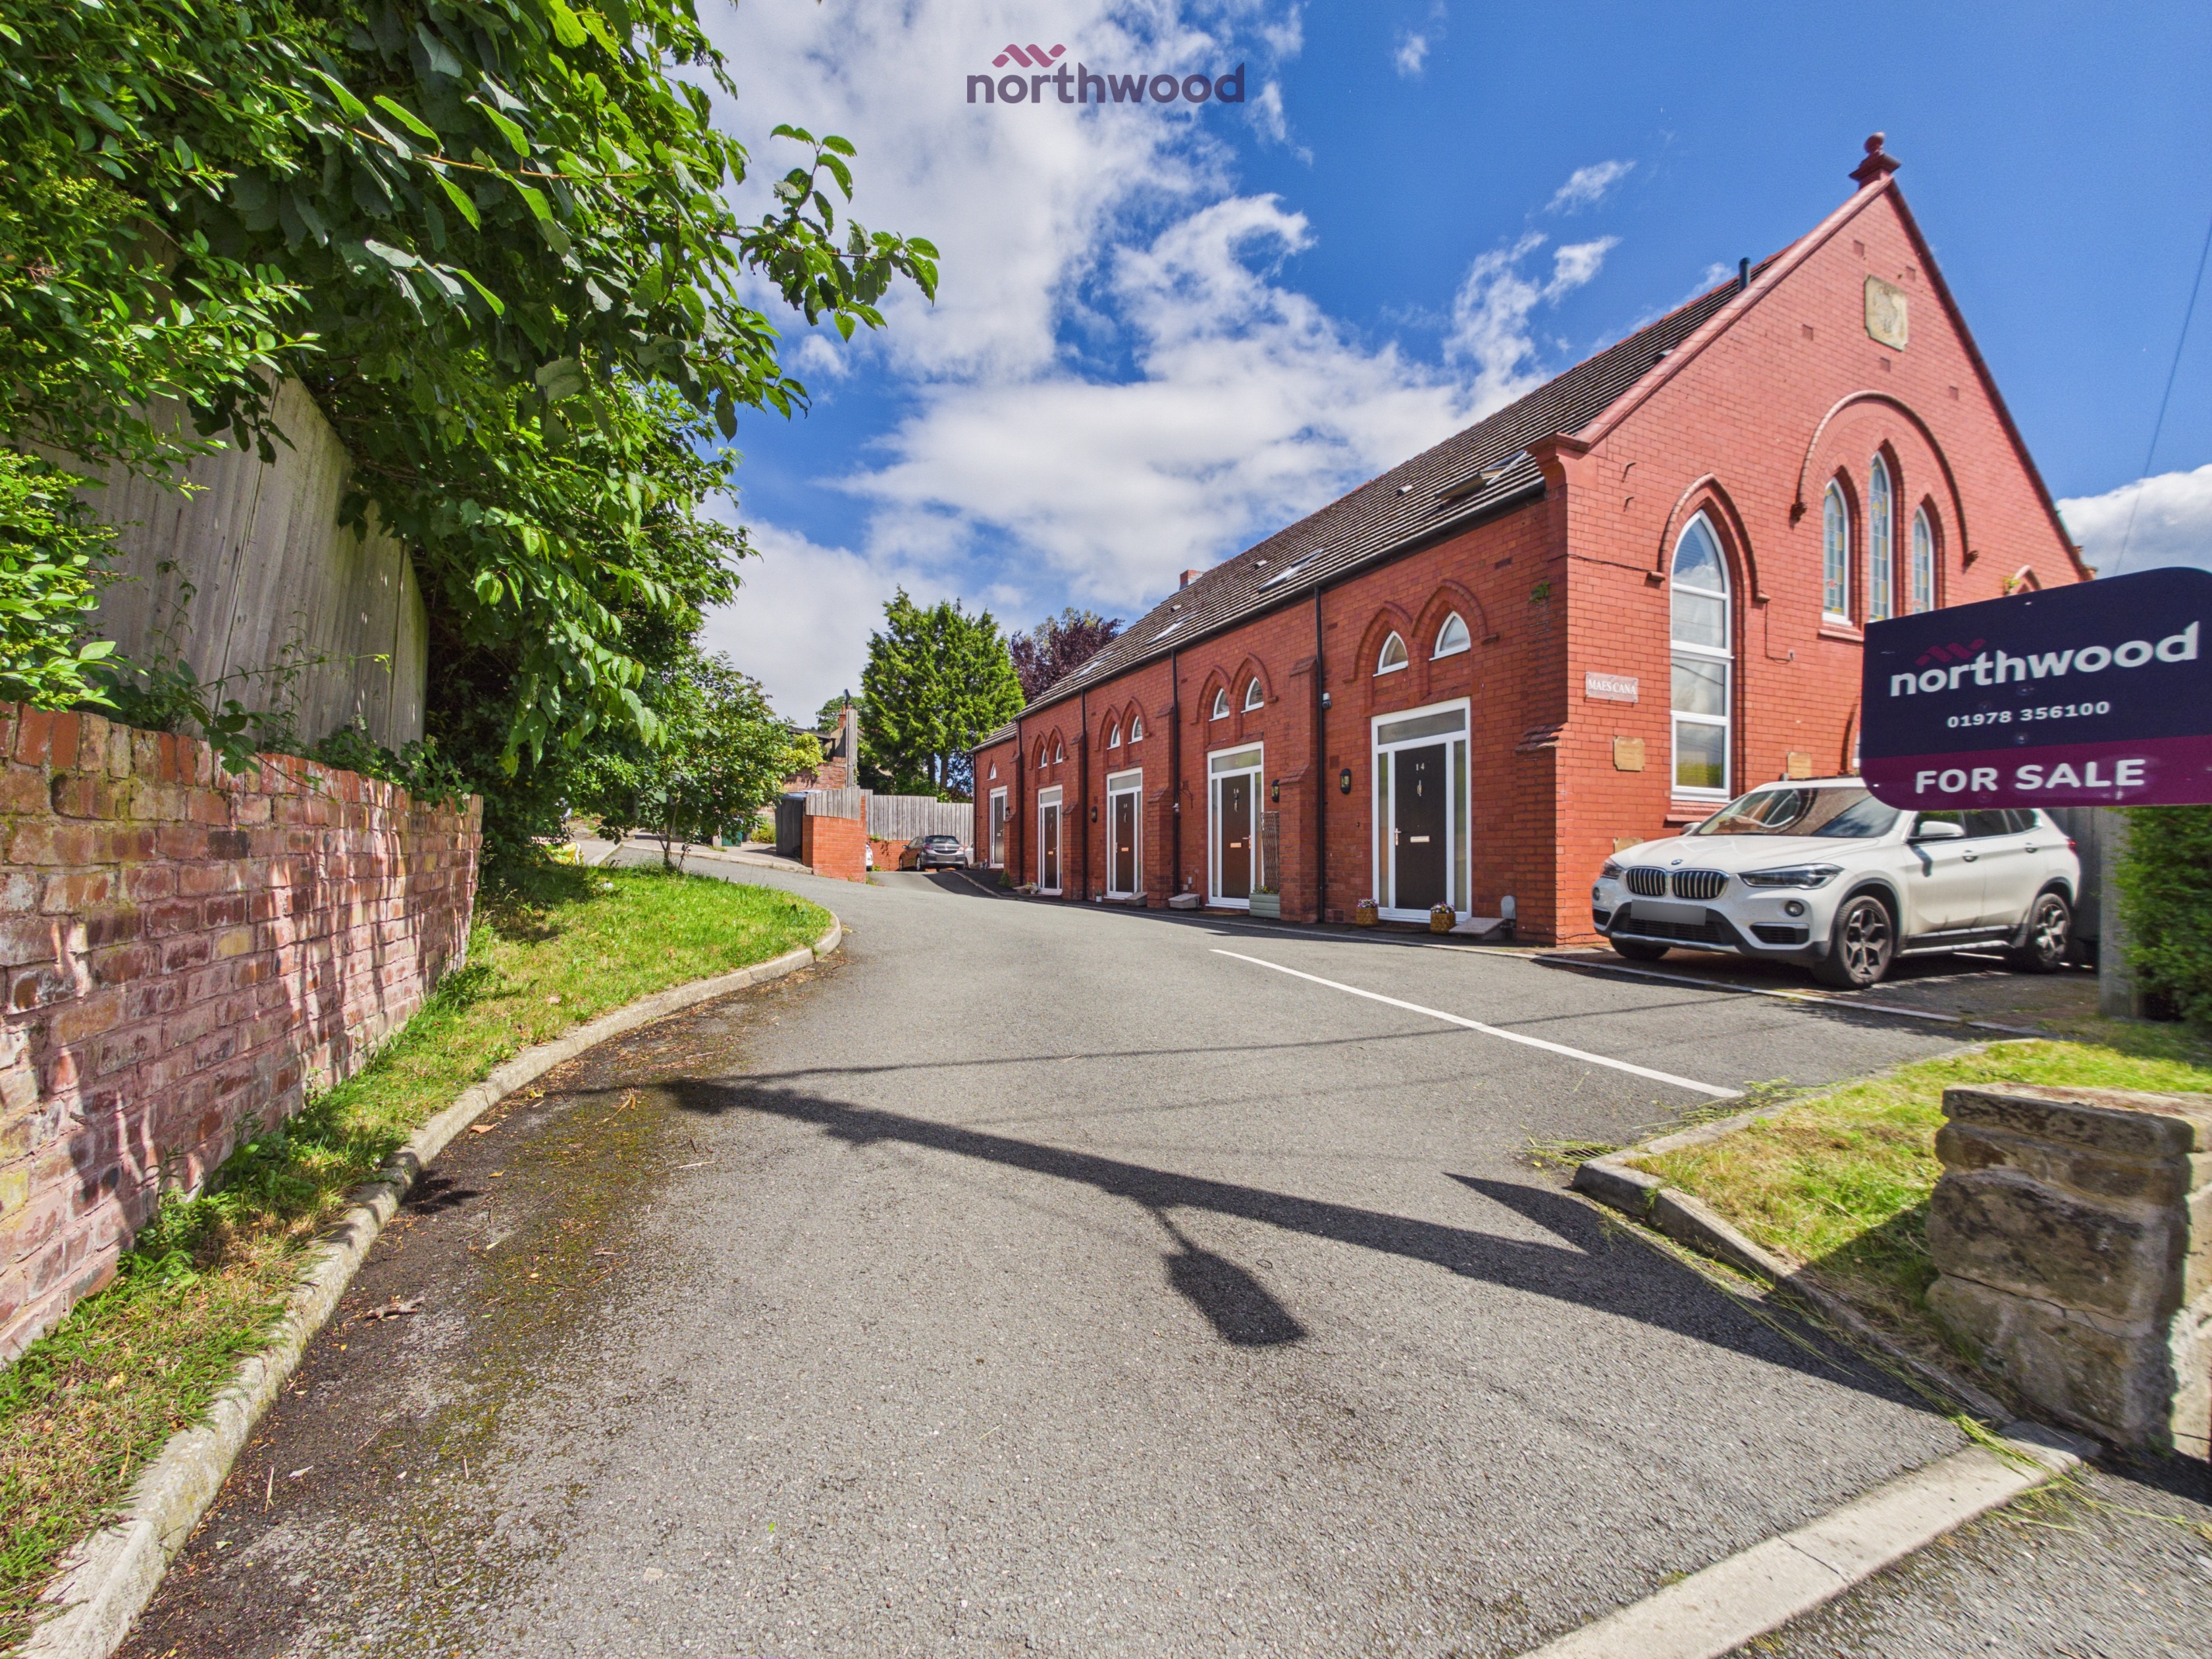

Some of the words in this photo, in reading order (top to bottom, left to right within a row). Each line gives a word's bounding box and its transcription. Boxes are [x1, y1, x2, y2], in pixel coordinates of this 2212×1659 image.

[1890, 621, 2199, 697] northwood
[1589, 679, 1612, 692] MAES
[1613, 682, 1636, 695] CANA
[1947, 710, 2011, 728] 01978
[2020, 701, 2110, 722] 356100
[1416, 762, 1425, 771] 14
[1916, 768, 1997, 793] FOR
[2015, 759, 2146, 790] SALE
